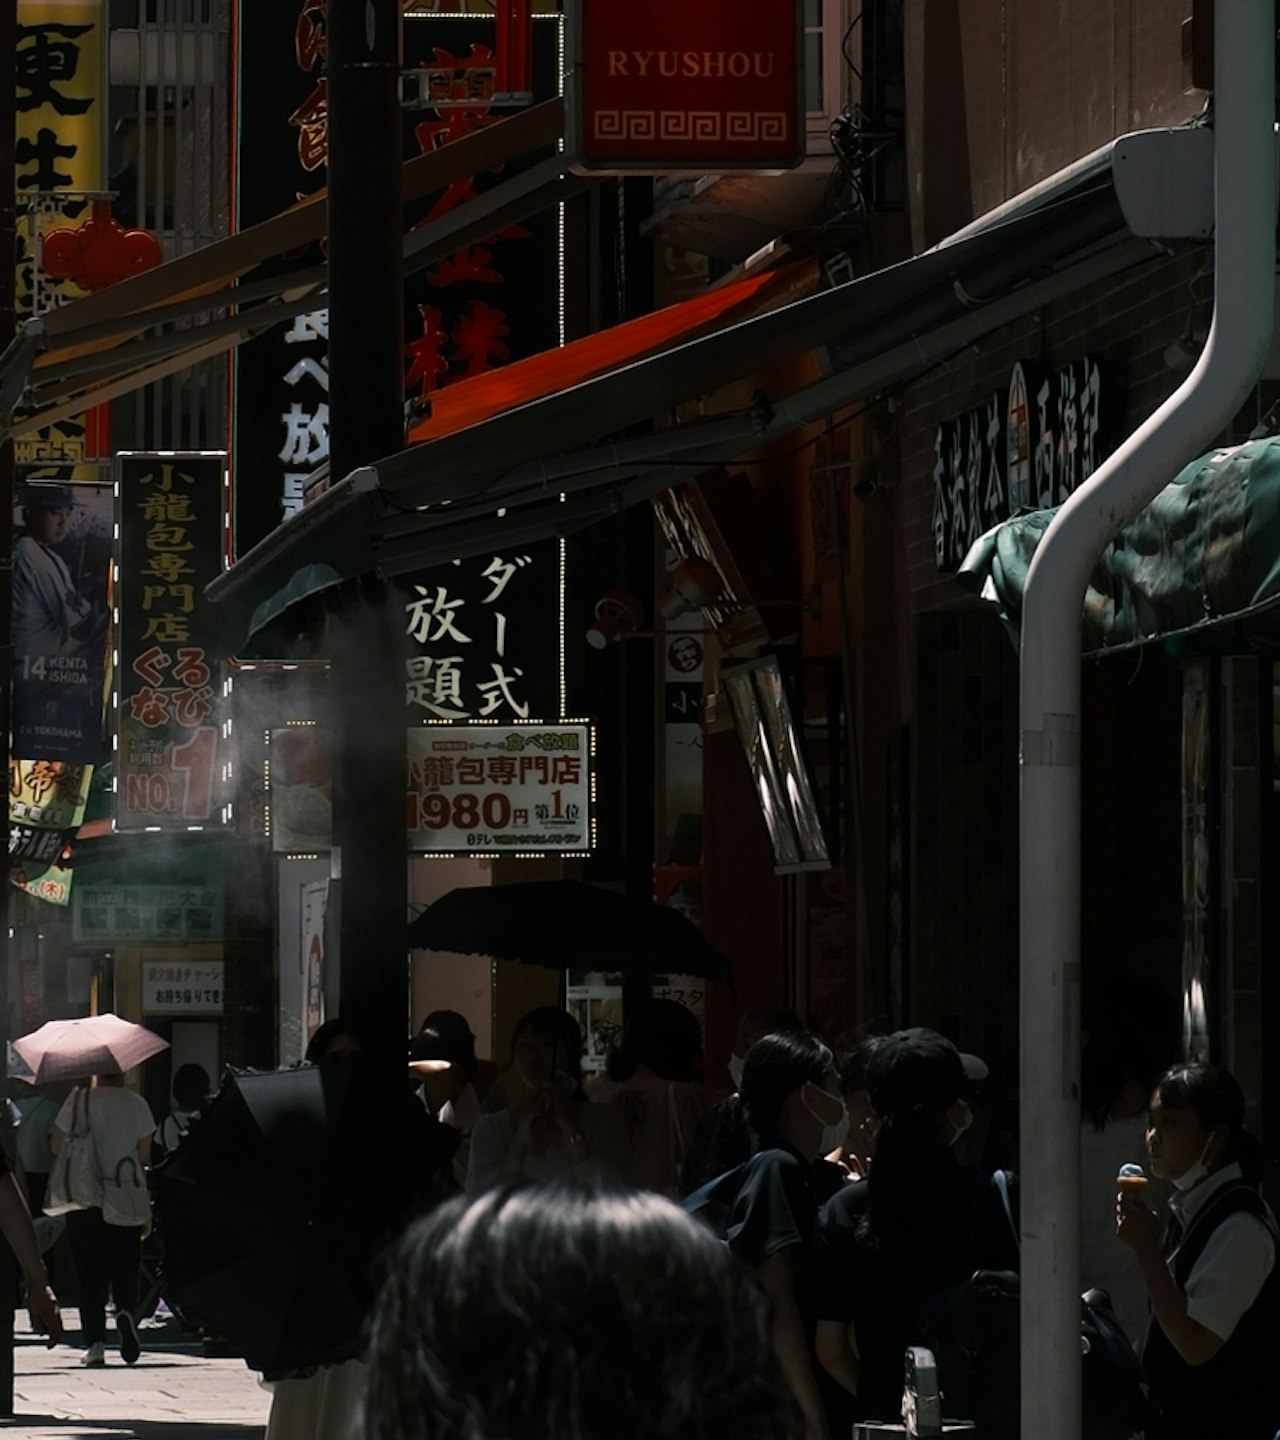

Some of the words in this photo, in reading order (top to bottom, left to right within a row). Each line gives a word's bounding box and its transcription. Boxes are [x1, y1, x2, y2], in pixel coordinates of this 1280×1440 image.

[607, 50, 775, 78] RYUSHOU
[22, 653, 48, 681] 14
[49, 656, 89, 670] KENTA
[49, 669, 89, 684] ISHIDA
[132, 645, 211, 688] ぐる
[131, 686, 215, 727] なび
